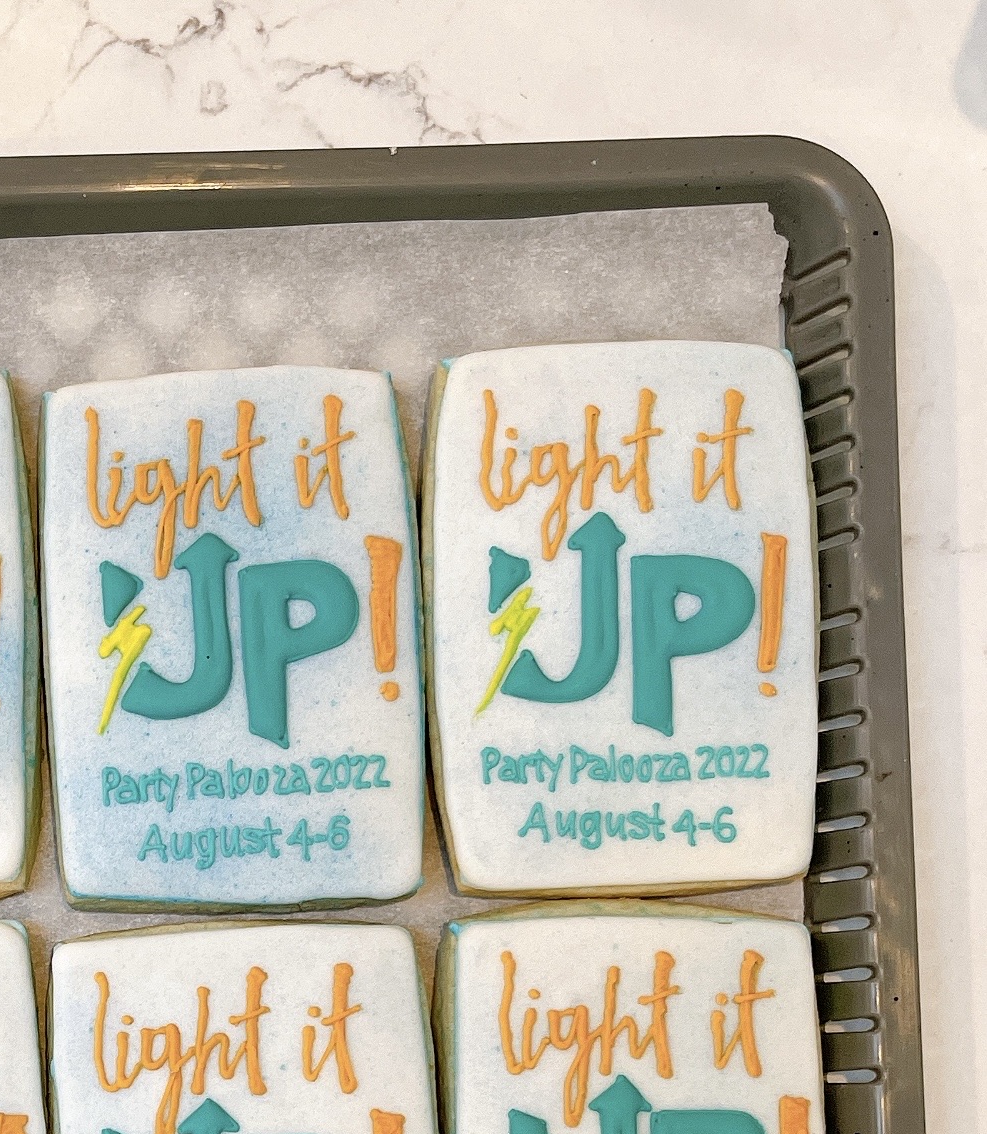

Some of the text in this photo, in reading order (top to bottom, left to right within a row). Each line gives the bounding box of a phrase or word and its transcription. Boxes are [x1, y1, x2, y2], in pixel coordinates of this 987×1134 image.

[295, 395, 357, 518] it
[694, 389, 754, 509] it
[102, 754, 391, 812] Party Palooza 2022
[480, 744, 770, 792] Party Palooza 2022
[137, 815, 350, 870] August 4-6
[518, 802, 737, 850] August 4-6
[303, 963, 363, 1094] it
[711, 950, 777, 1077] it
